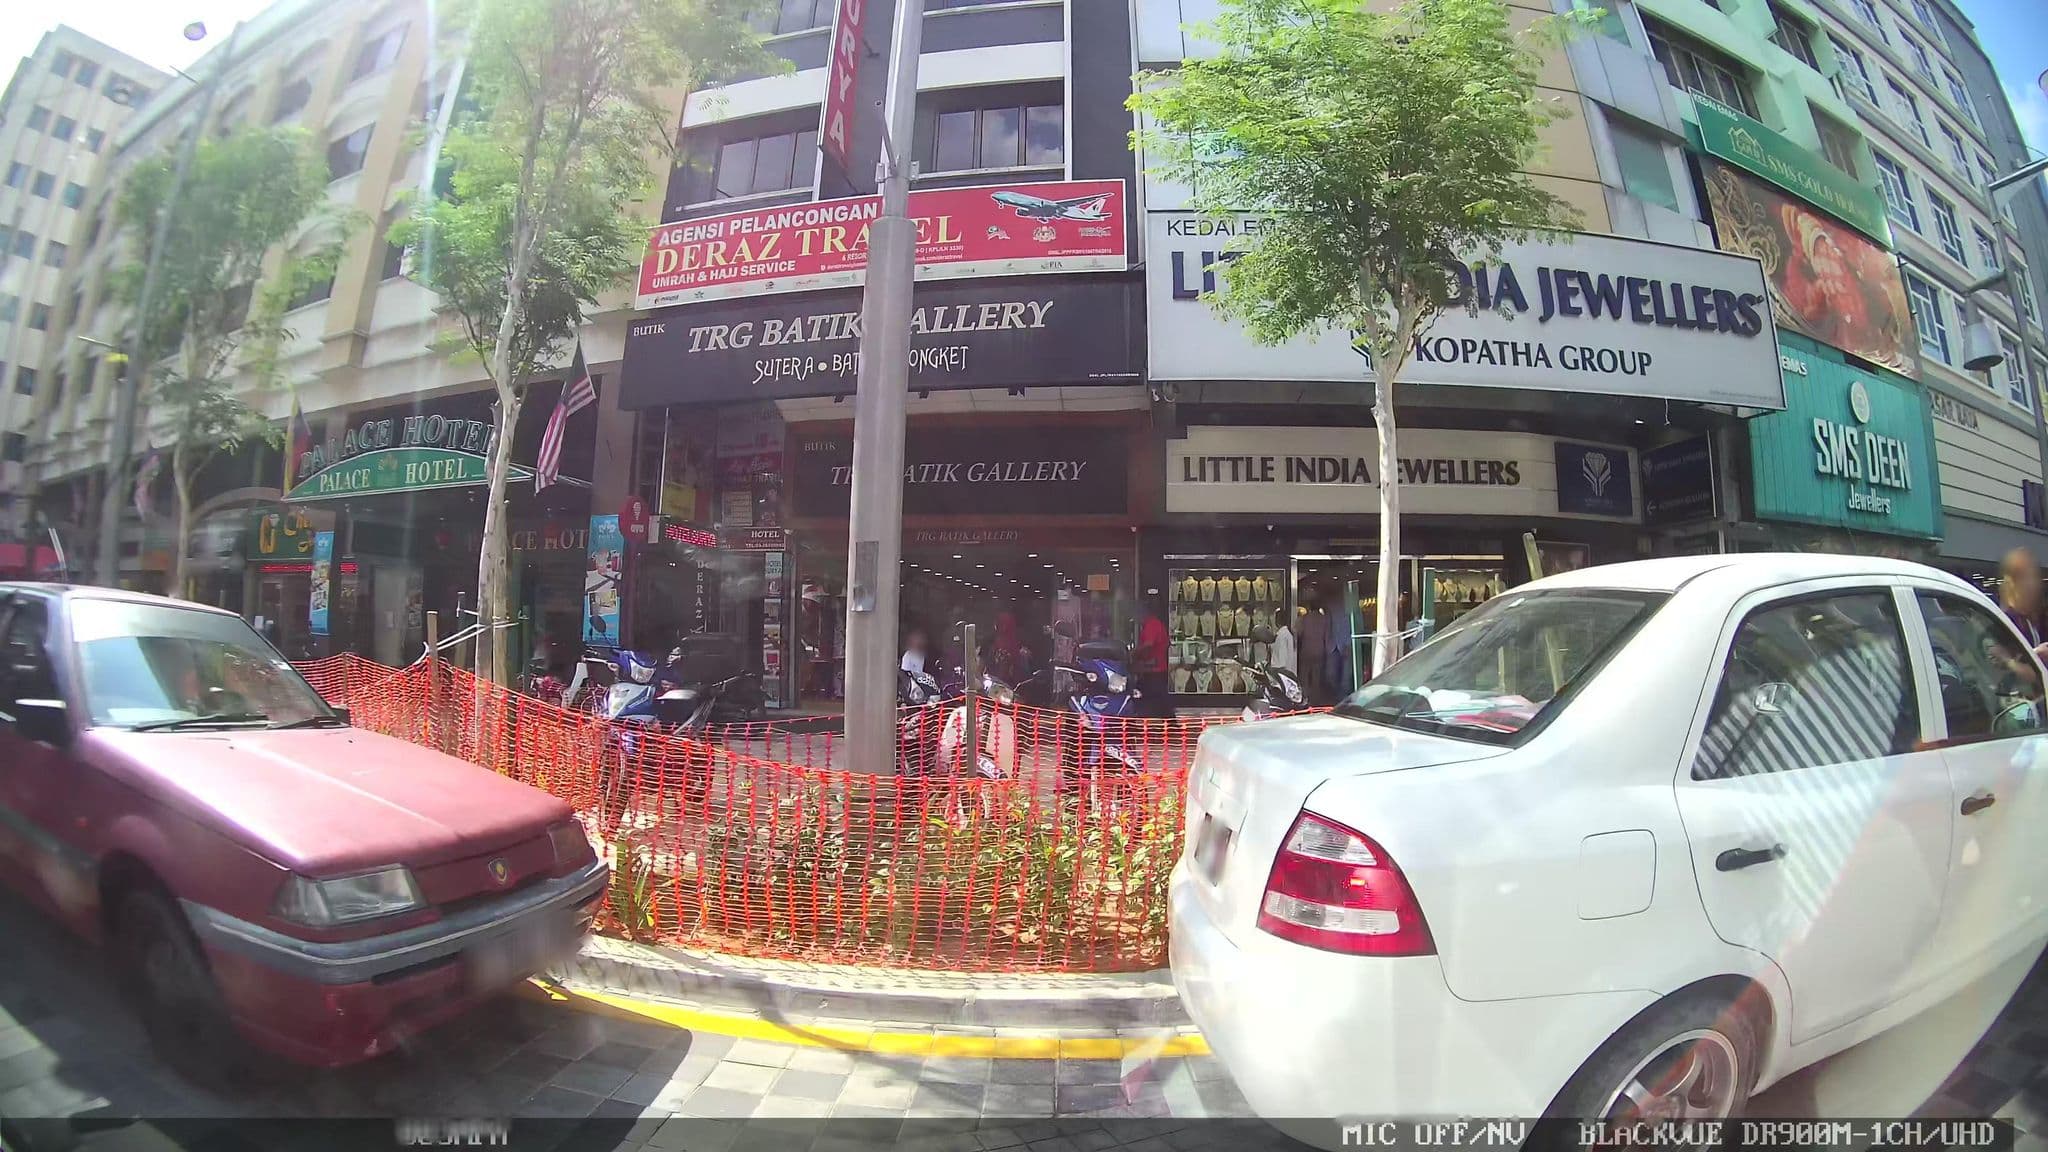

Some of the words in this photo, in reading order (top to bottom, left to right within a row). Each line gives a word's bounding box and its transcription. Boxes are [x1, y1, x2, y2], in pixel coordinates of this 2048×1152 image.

[658, 222, 723, 247] AGENSI
[730, 202, 878, 236] PELANCONGAN
[655, 232, 782, 276] DERAZ
[795, 215, 962, 257] TRAEL
[652, 273, 694, 289] UMRAH
[697, 268, 706, 282] &
[710, 264, 738, 280] HAJJ
[741, 259, 796, 277] SERVICE
[1537, 266, 1763, 338] JEWELLERS
[633, 323, 666, 337] BUTIK
[688, 322, 754, 353] TRG
[759, 311, 864, 347] BATIK
[908, 300, 1054, 335] ALLERY
[752, 355, 813, 385] SUTERA
[832, 352, 861, 378] BAT
[908, 345, 969, 374] ONGKET
[1416, 335, 1553, 370] KOPATHA
[1559, 344, 1653, 377] GROUP
[299, 419, 392, 479] PALACE
[1813, 416, 1863, 480] SMS
[1864, 430, 1912, 491] DEEN
[319, 467, 372, 494] PALACE
[404, 456, 468, 485] HOTEL
[902, 463, 961, 485] ATIK
[967, 460, 1087, 483] GALLERY
[1183, 456, 1275, 483] LITTLE
[1285, 456, 1372, 484] INDIA
[1848, 484, 1892, 515] Jewellers
[751, 529, 780, 540] HOTEL
